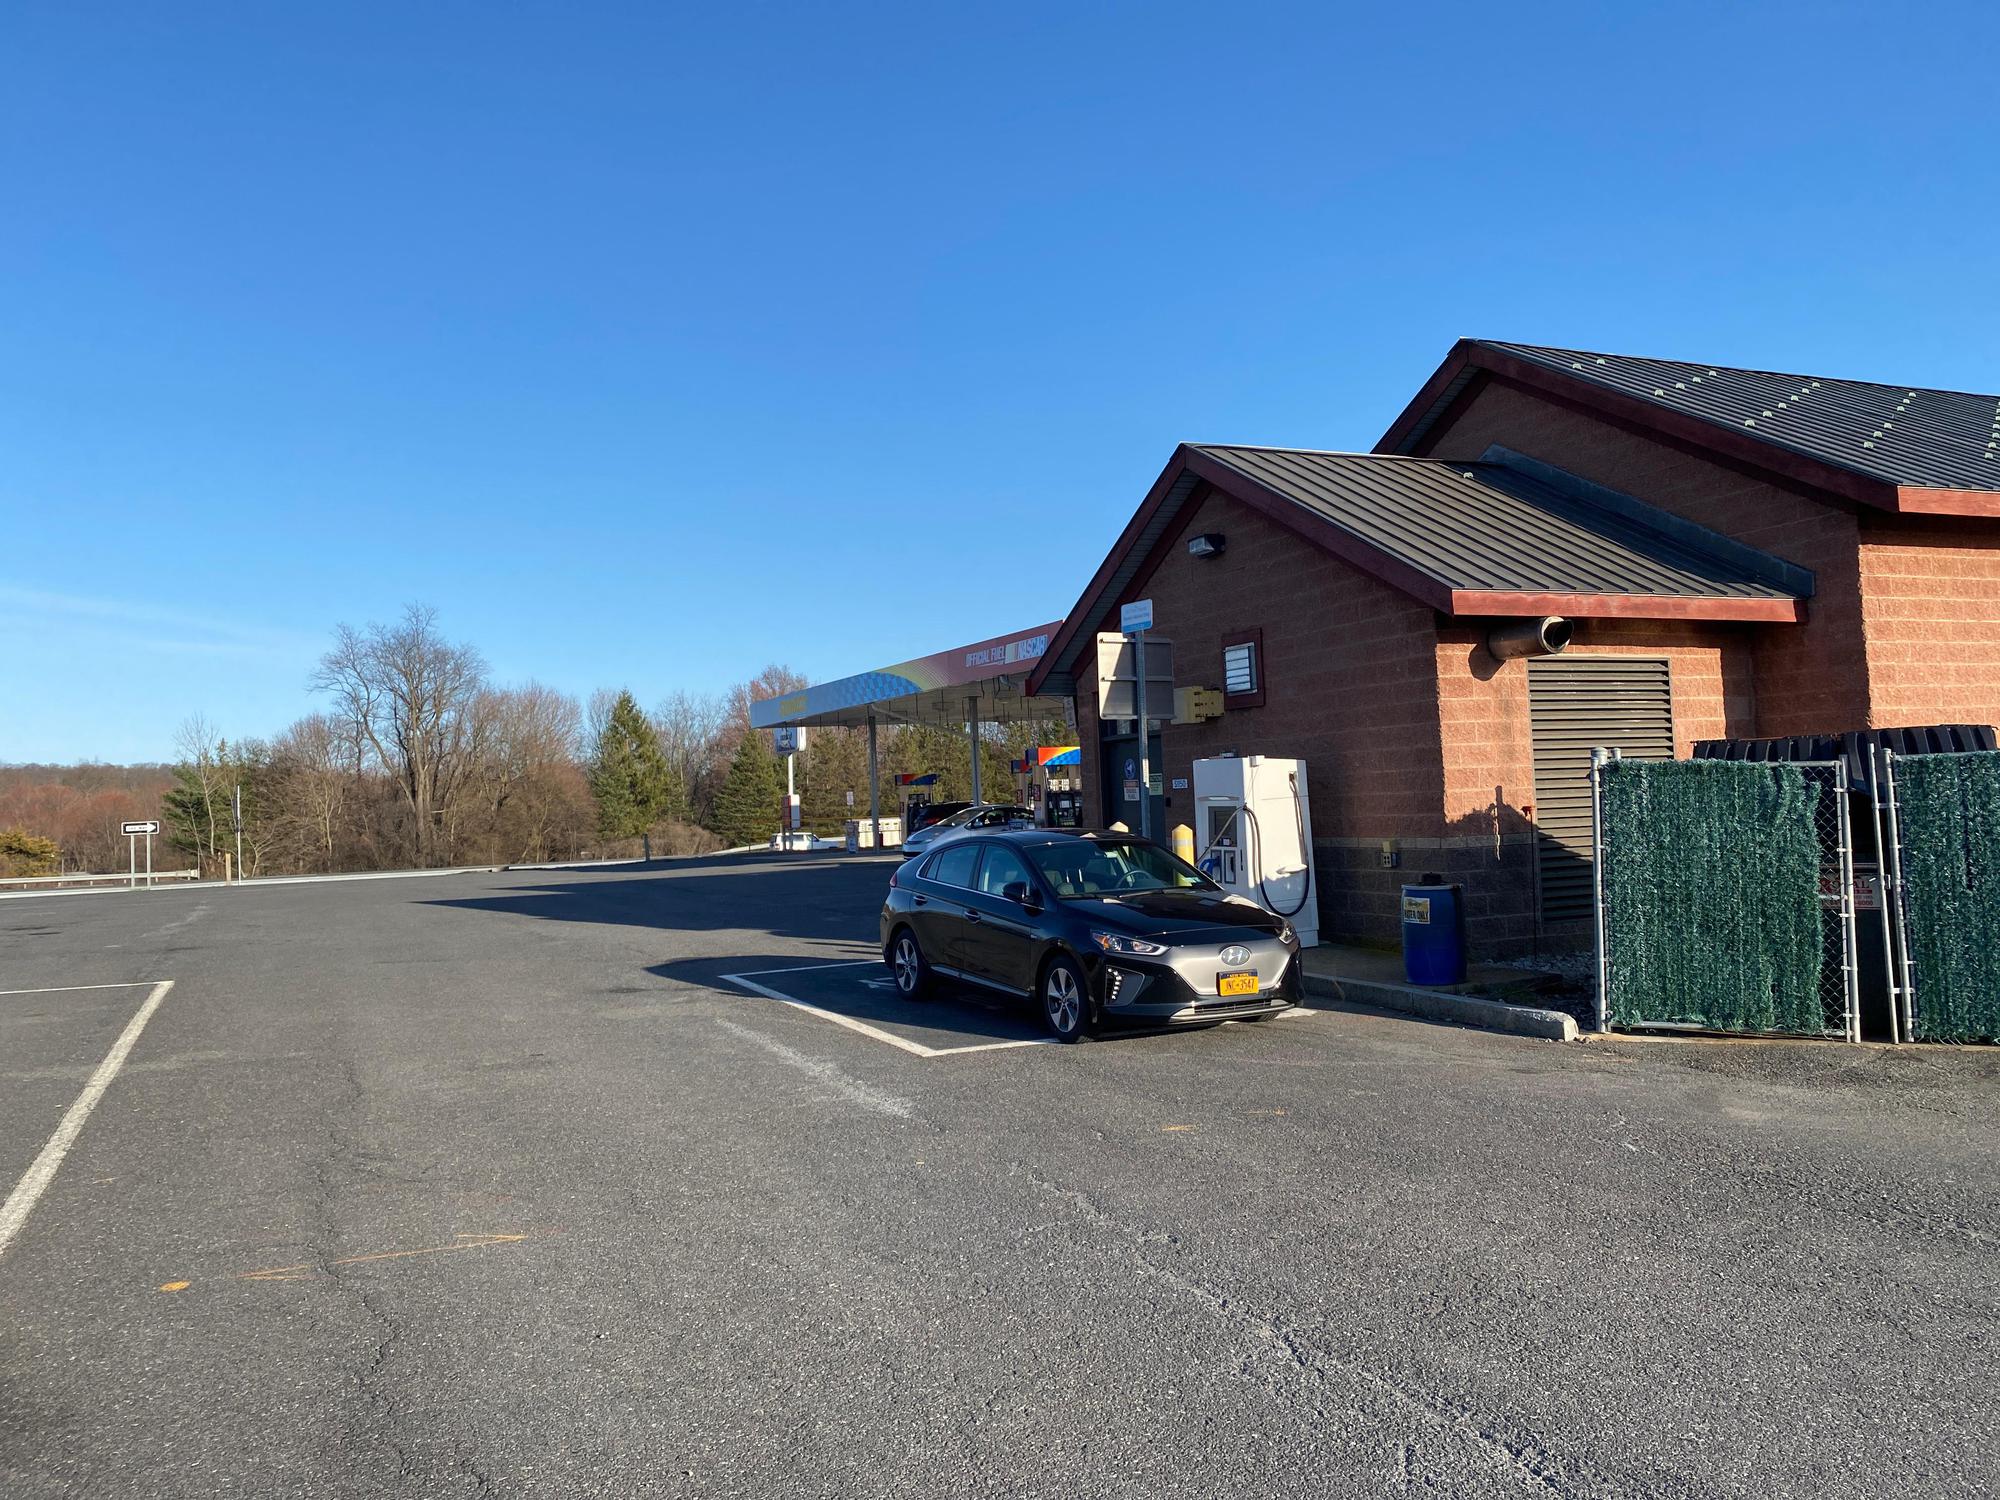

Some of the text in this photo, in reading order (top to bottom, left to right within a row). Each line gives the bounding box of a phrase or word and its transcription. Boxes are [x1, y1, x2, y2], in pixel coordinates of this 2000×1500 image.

[966, 634, 1048, 667] OFFICIAL FUEL NASCAR
